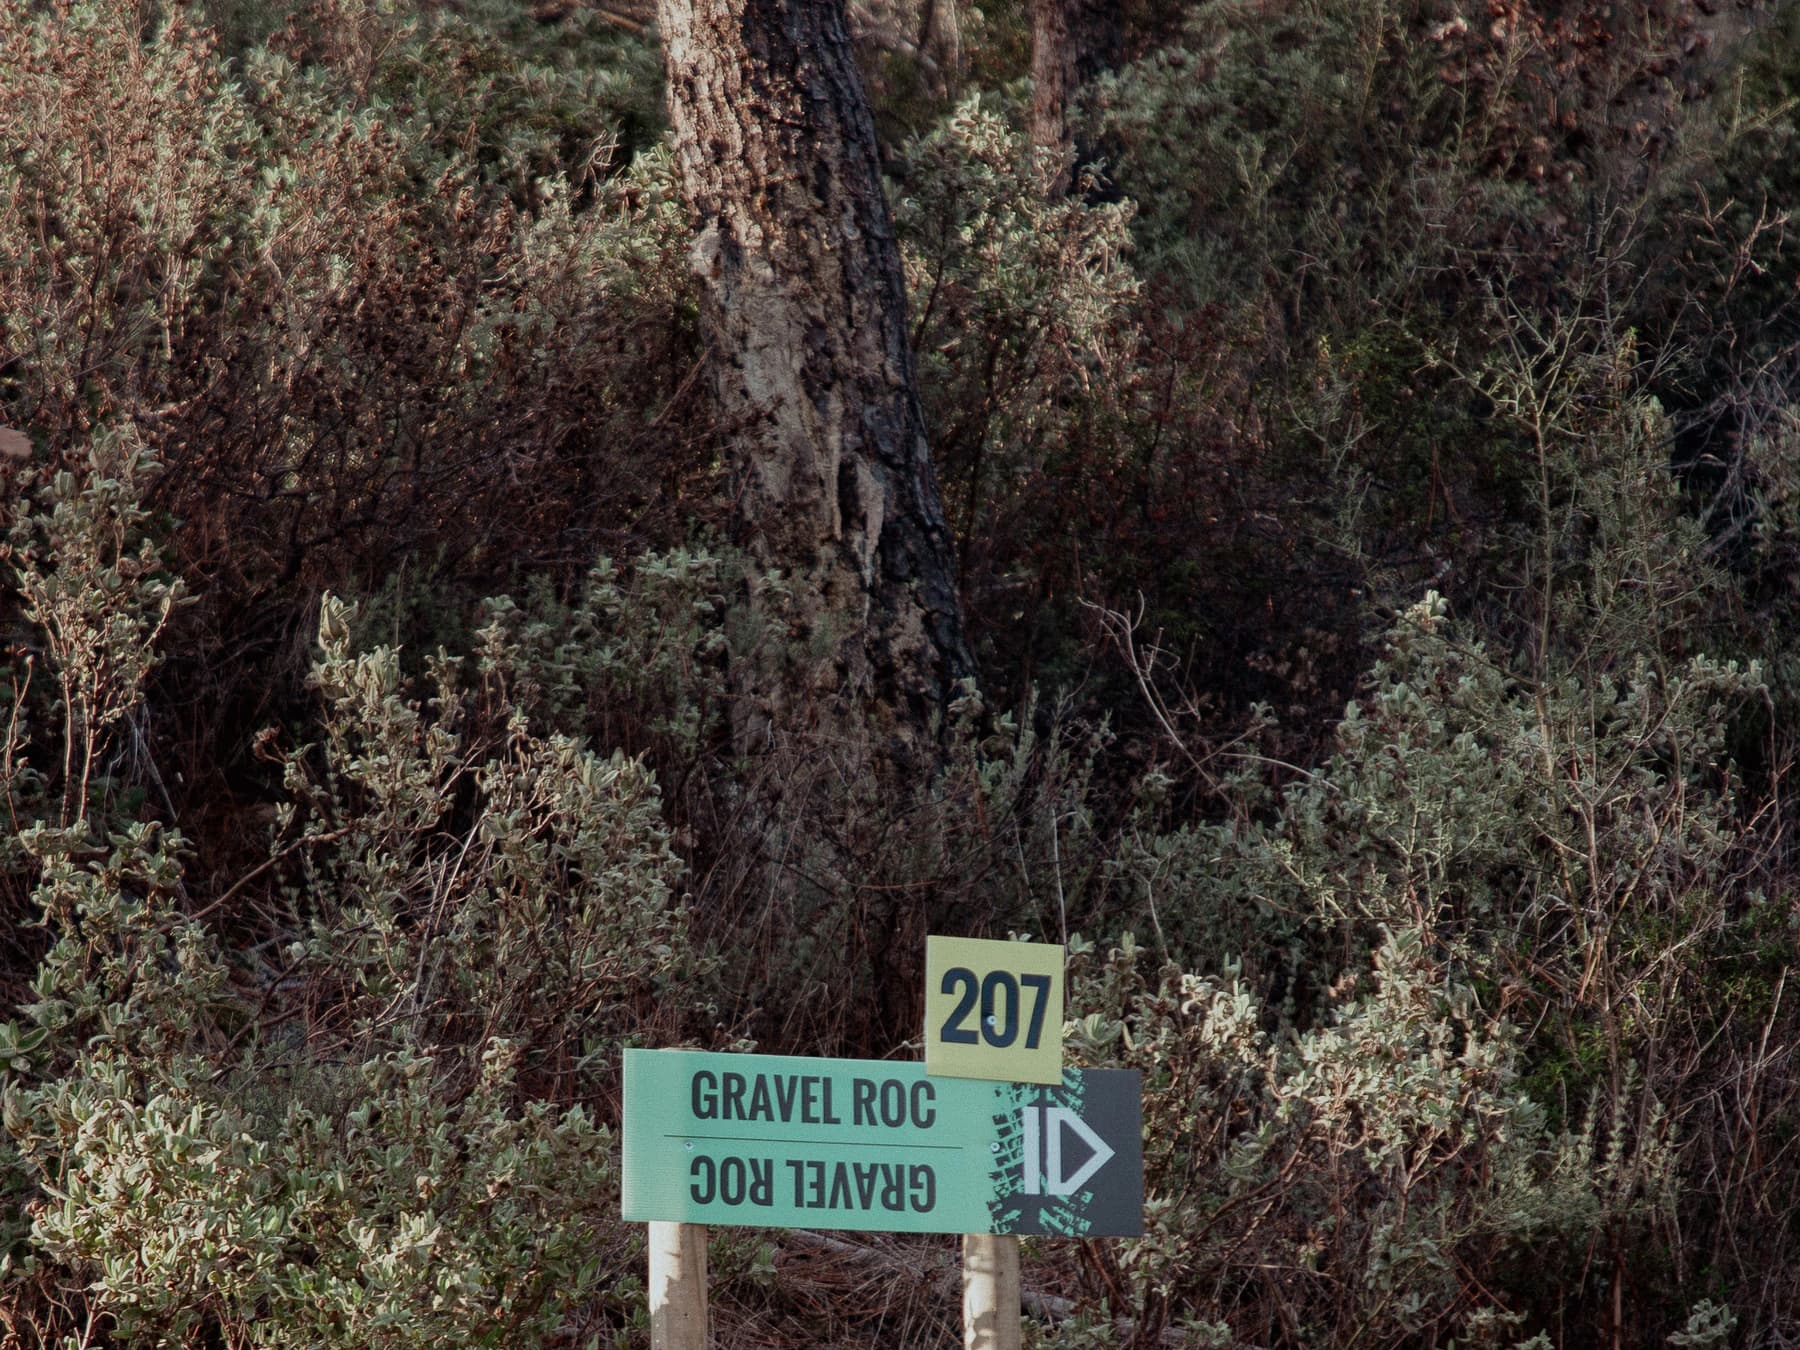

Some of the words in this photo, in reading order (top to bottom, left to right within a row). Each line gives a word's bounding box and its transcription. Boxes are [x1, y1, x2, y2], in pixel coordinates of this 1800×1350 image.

[940, 967, 1053, 1050] 207
[691, 1069, 841, 1125] GRAVEL
[852, 1078, 937, 1130] ROC
[690, 1154, 774, 1206] ROC
[786, 1159, 936, 1213] GRAVEL
